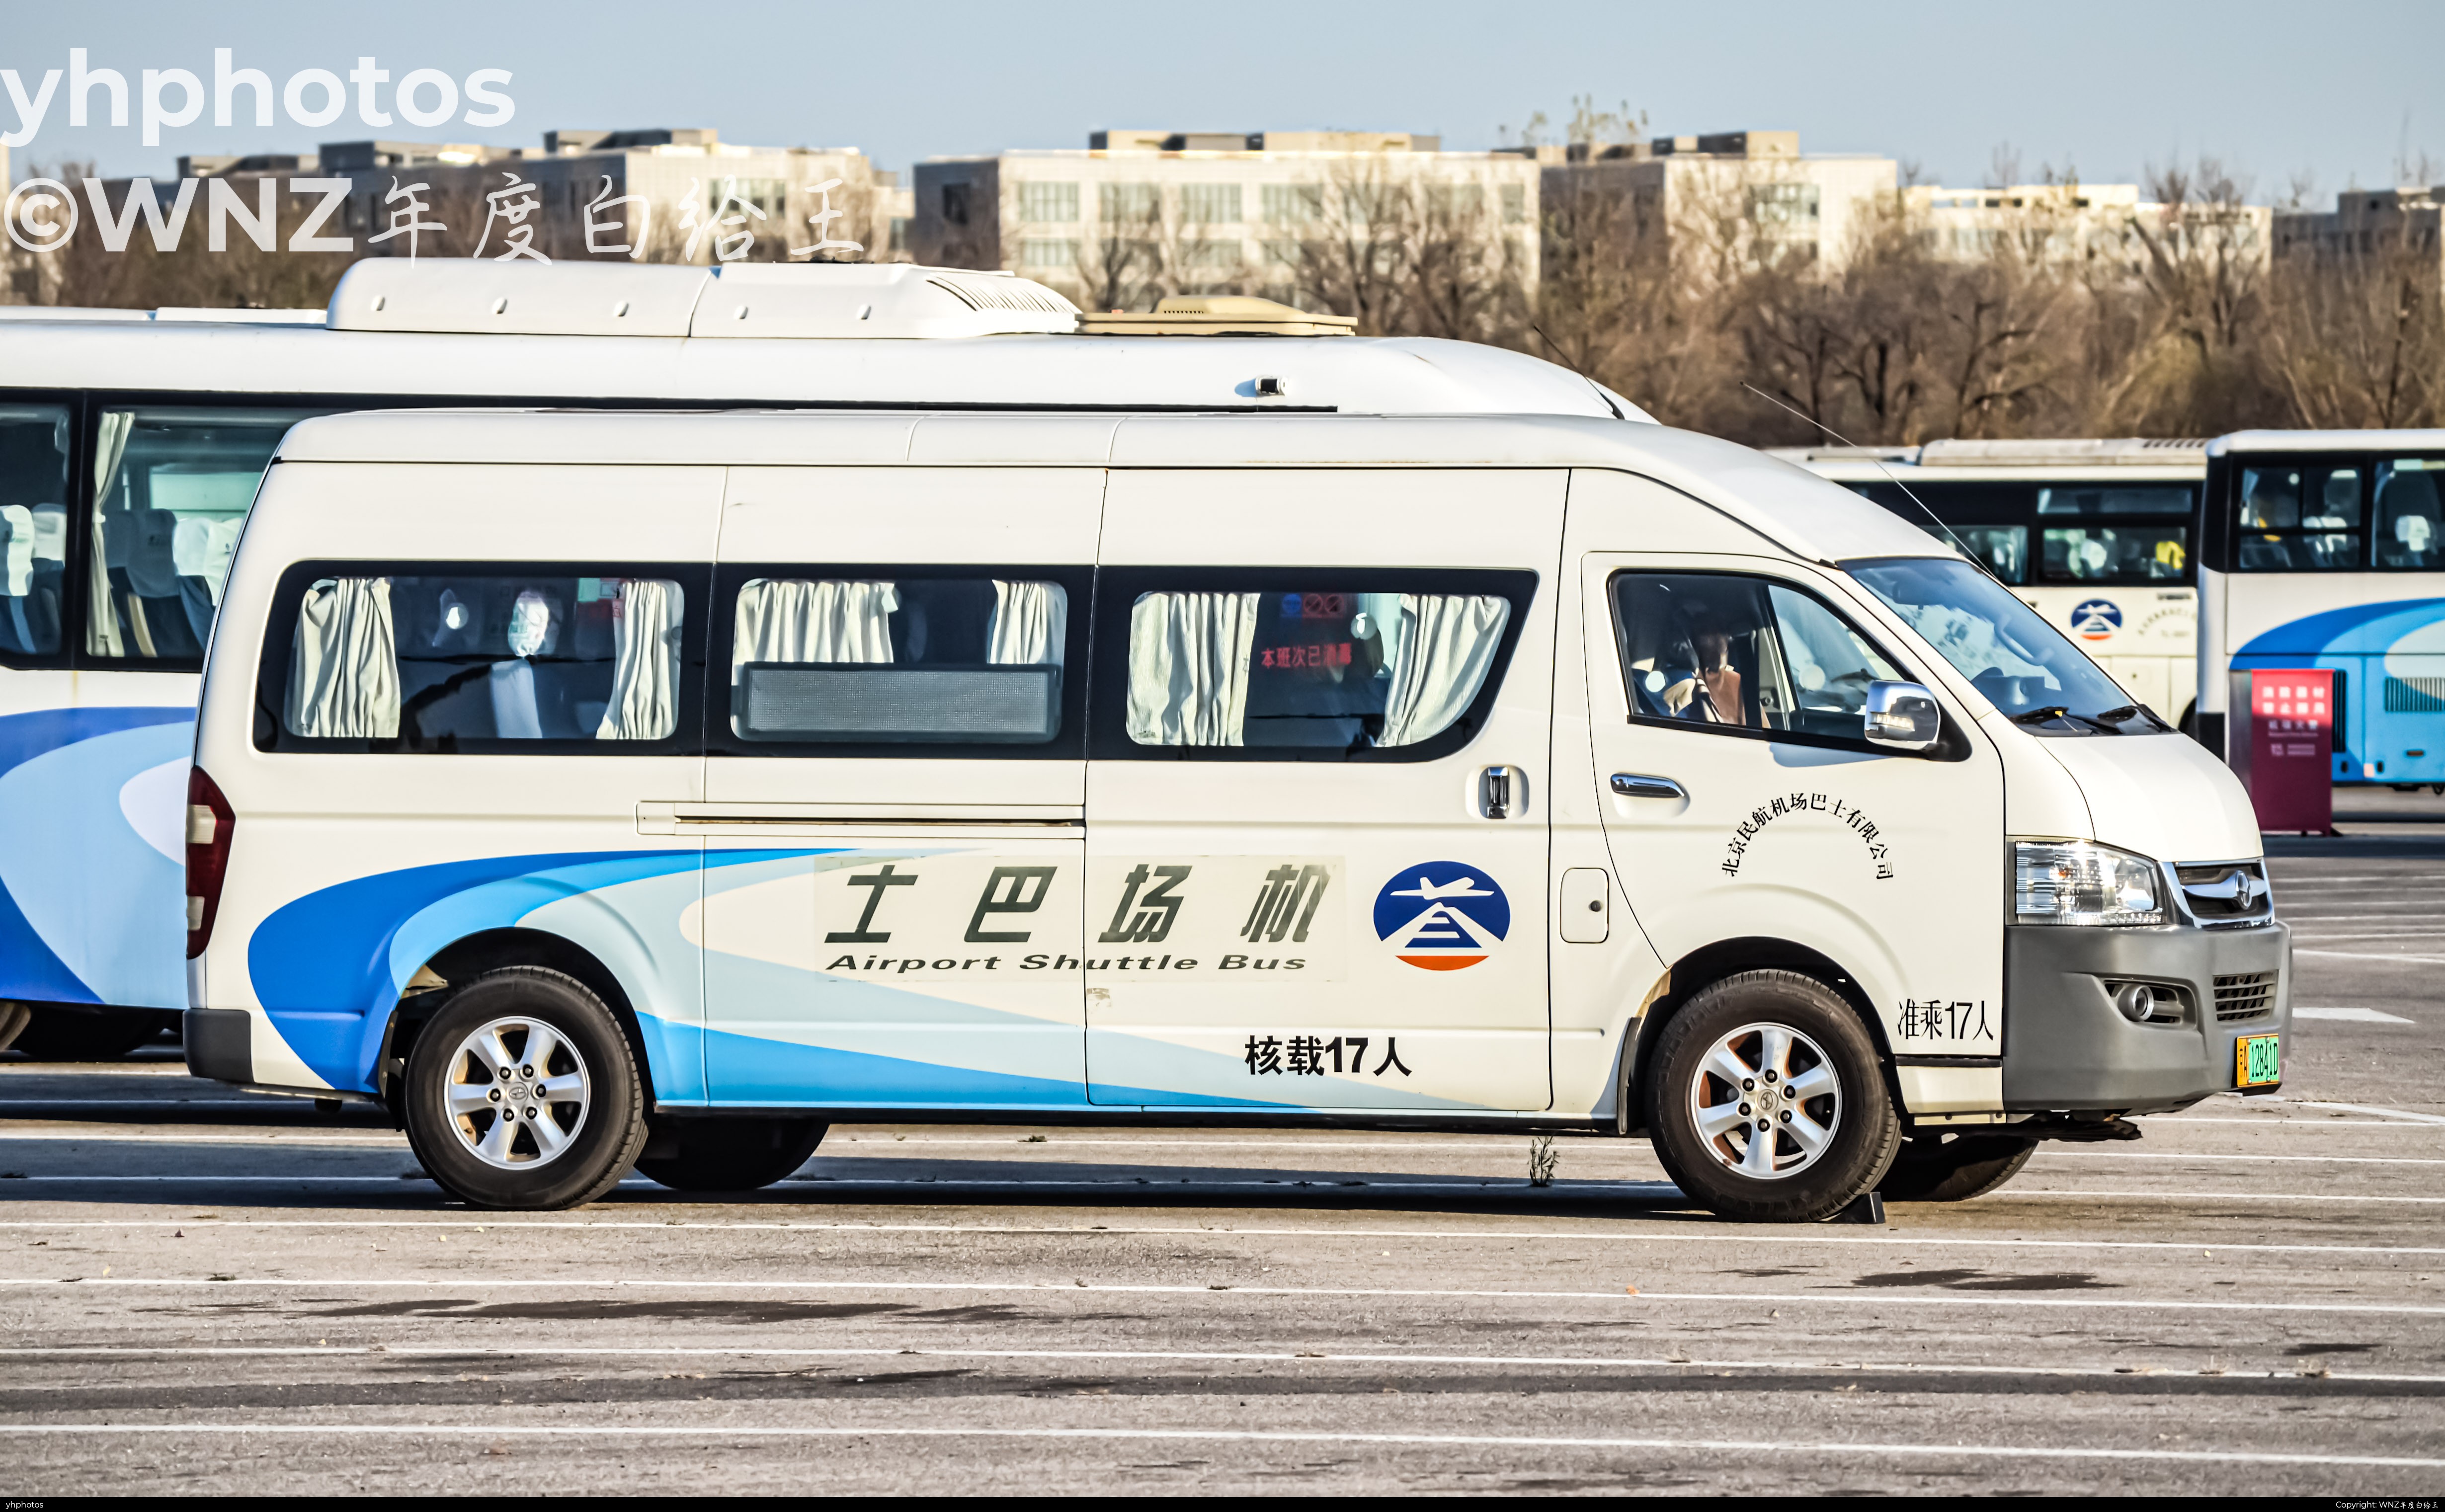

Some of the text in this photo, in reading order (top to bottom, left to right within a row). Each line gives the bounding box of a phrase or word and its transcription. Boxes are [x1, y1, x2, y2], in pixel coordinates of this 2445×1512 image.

[1721, 793, 1894, 879] 北京民航机场巴士有限公司
[825, 954, 1307, 974] Airport Shuttle Bus
[1897, 998, 1994, 1041] 准乘17人
[1244, 1035, 1412, 1077] 核载17人
